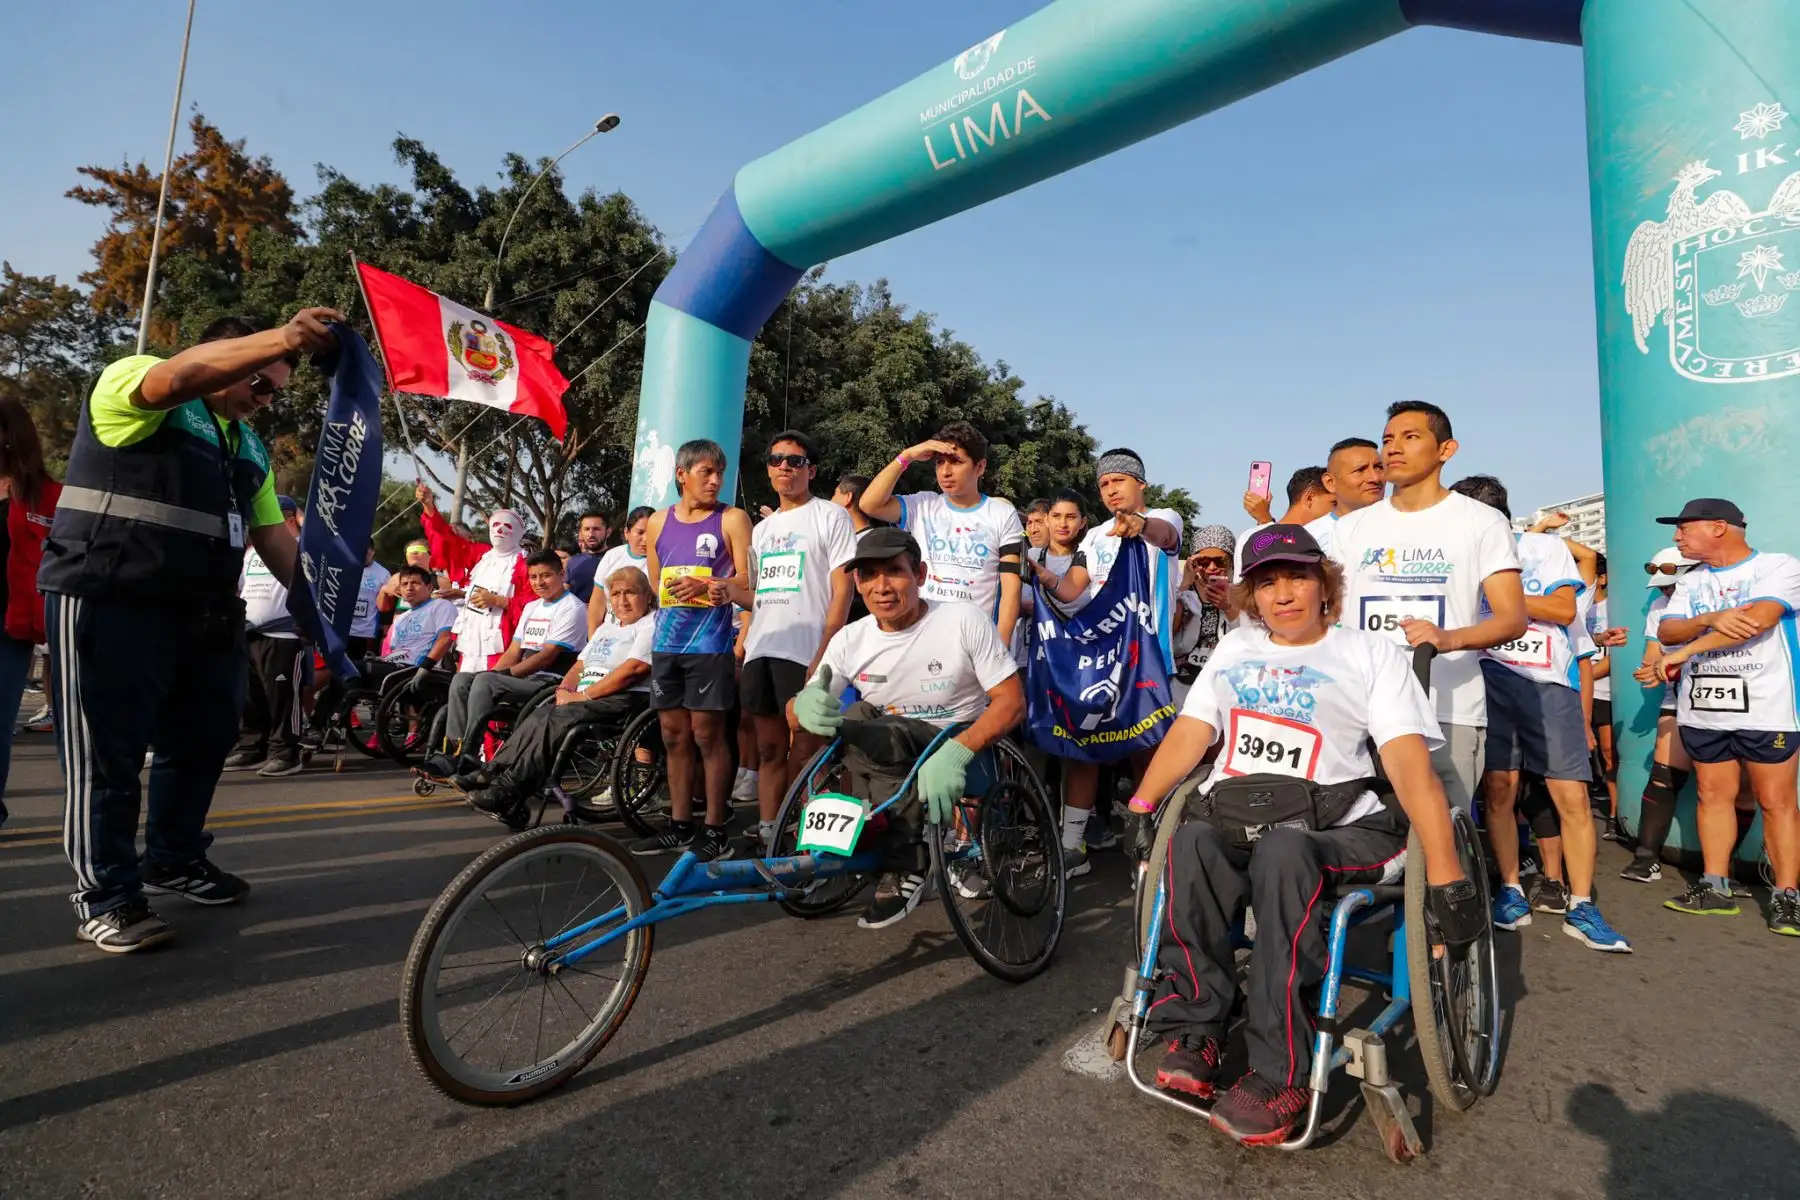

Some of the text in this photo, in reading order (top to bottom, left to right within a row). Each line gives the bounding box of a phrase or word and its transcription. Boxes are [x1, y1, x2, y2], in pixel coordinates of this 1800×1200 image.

[919, 56, 1037, 123] MUNICIPALIDAD DE
[923, 88, 1053, 171] LIMA
[321, 422, 349, 477] LIMA
[339, 411, 367, 485] CORRE
[943, 553, 986, 567] DROGAS
[1402, 548, 1445, 562] LIMA
[1401, 562, 1455, 575] CORRE
[322, 566, 343, 625] LIMA
[937, 587, 973, 601] DEVIDA
[1708, 649, 1753, 659] DEVIDA
[921, 679, 958, 693] LIMA
[1262, 685, 1317, 709] VVO
[1694, 687, 1738, 700] 3751
[1128, 702, 1177, 740] AUDITIV
[1238, 733, 1303, 770] 3991
[805, 811, 856, 833] 3877
